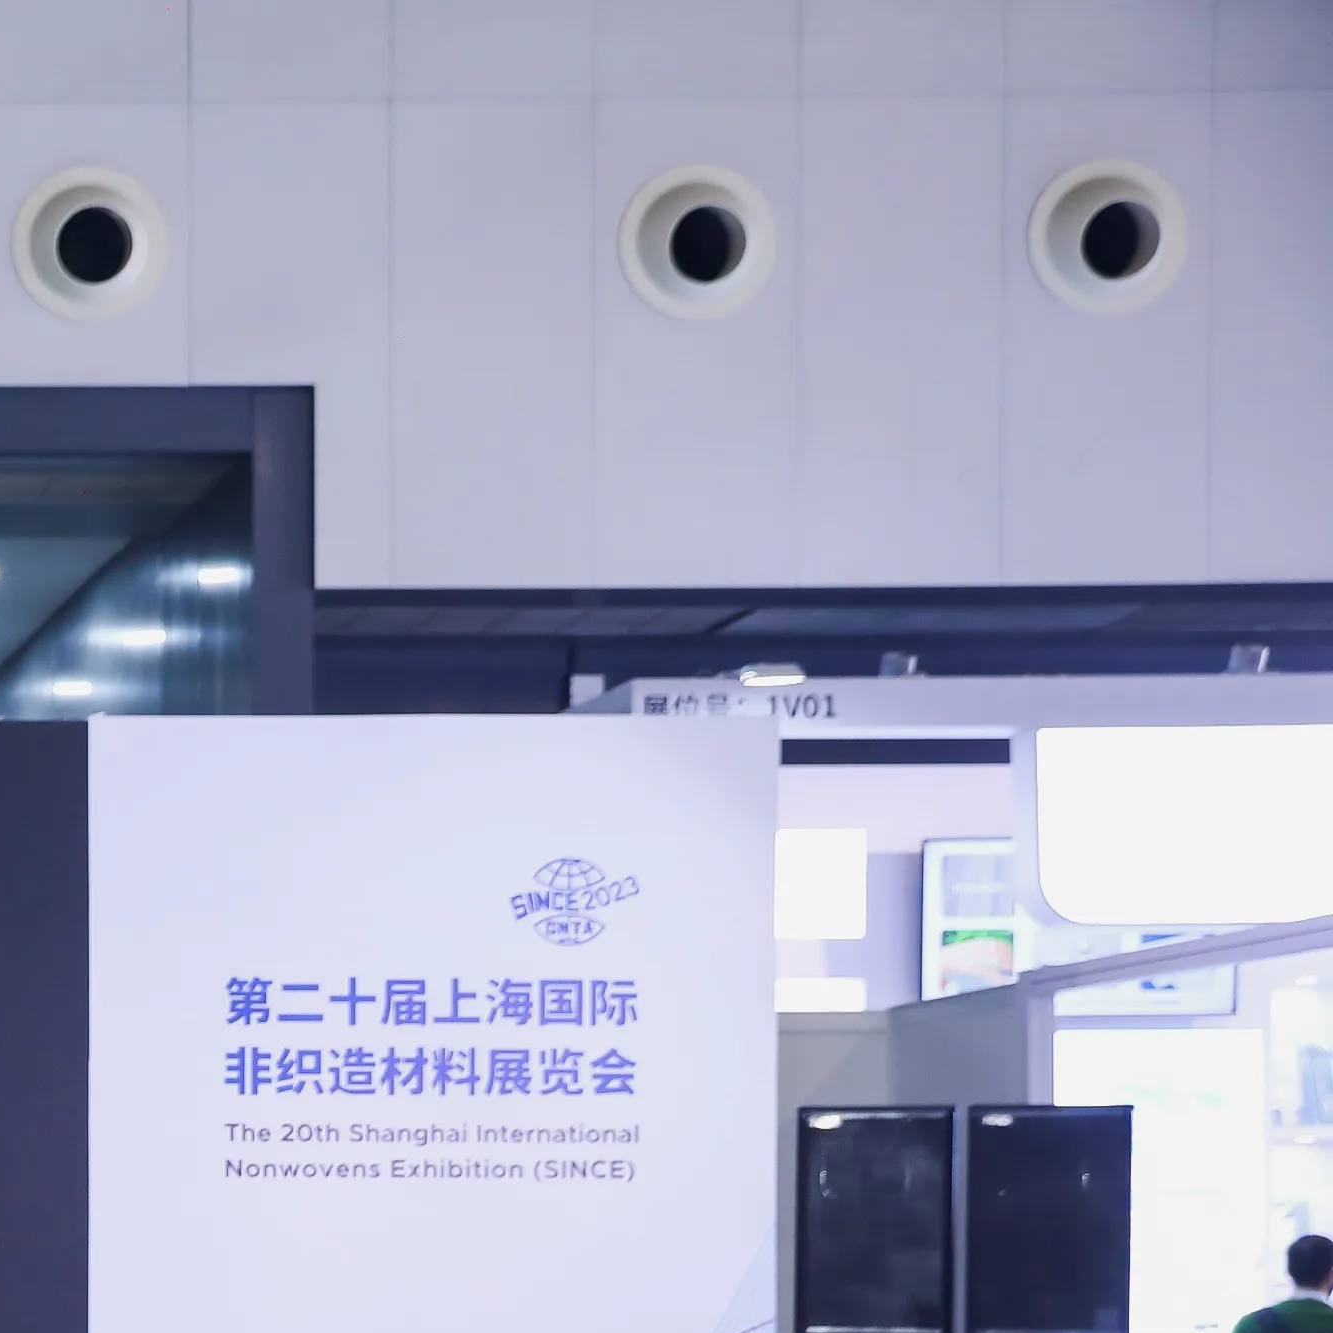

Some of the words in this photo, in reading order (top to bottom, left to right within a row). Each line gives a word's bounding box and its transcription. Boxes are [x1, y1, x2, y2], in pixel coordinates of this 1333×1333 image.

[226, 977, 639, 1027] 第二十届上海国际
[224, 1048, 636, 1096] 非织造材料展览会
[225, 1123, 271, 1144] The
[281, 1123, 340, 1144] 20th
[348, 1122, 468, 1148] Shanghai
[476, 1123, 641, 1145] International
[224, 1159, 380, 1180] Nonwovens
[391, 1159, 524, 1181] Exhibition
[534, 1159, 636, 1183] (SINCE)
